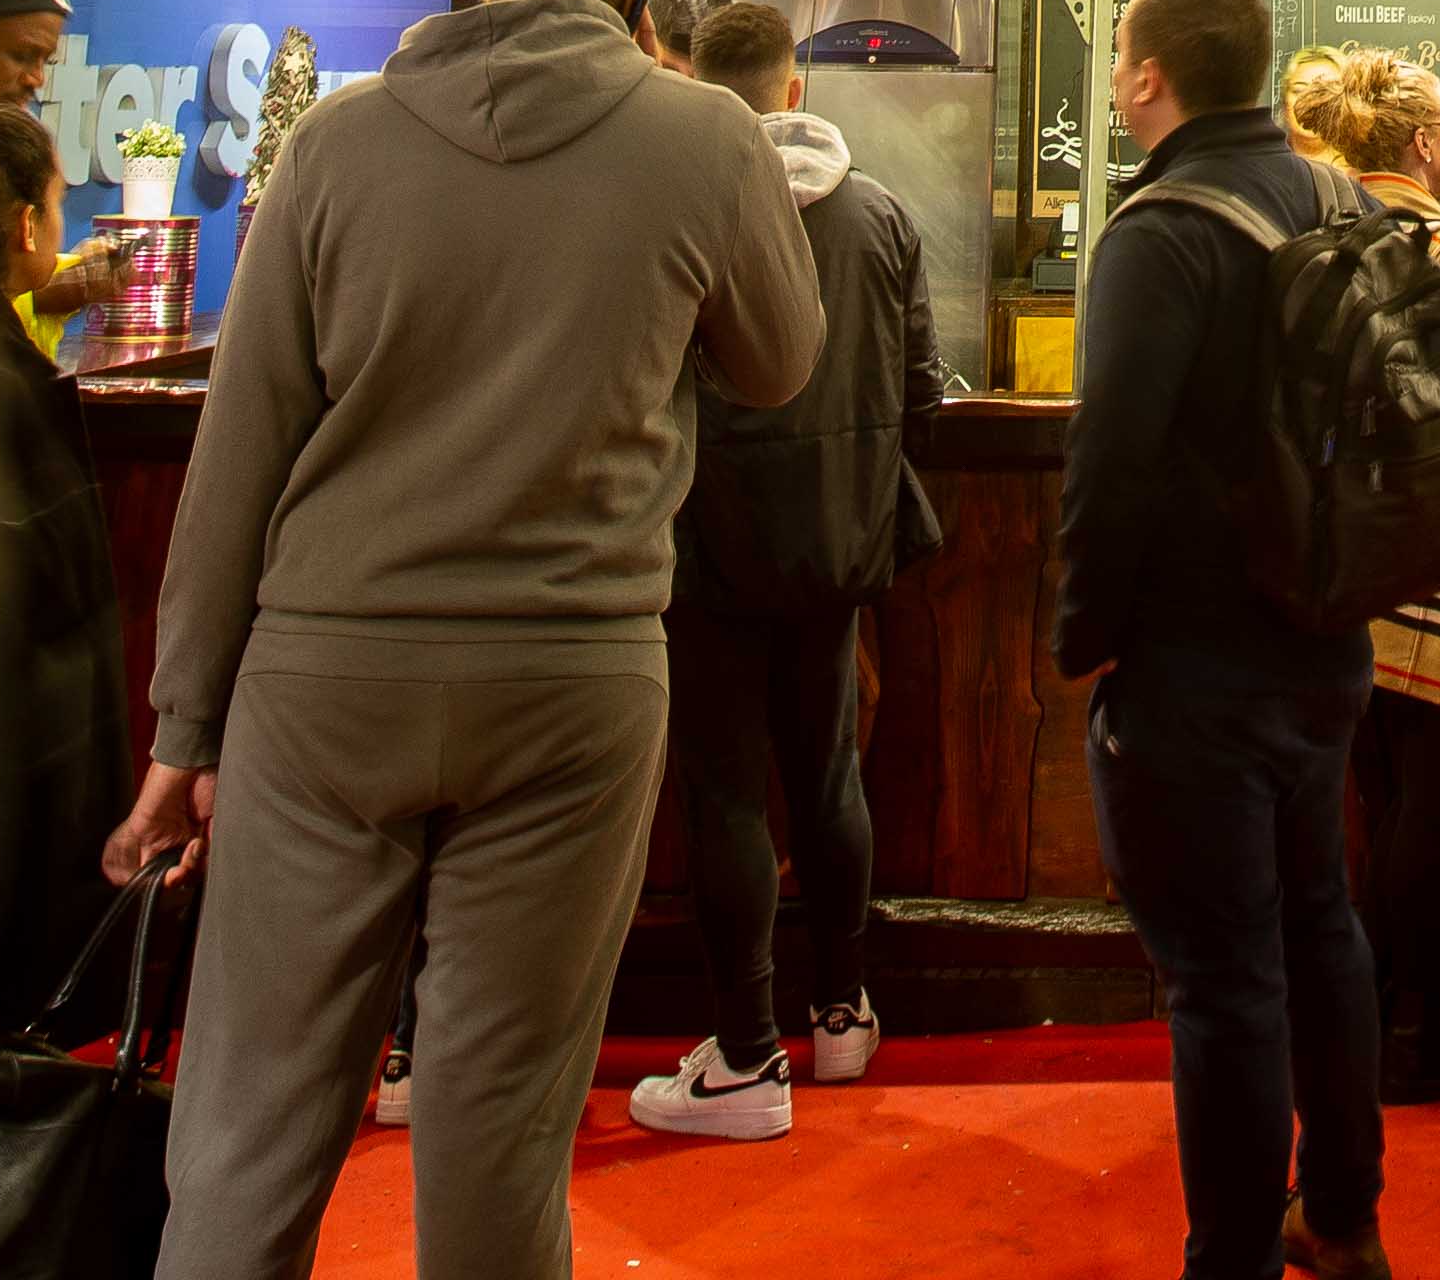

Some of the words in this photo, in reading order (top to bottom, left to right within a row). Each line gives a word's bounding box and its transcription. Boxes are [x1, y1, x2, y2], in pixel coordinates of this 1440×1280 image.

[1335, 5, 1375, 24] CHILLI
[1376, 5, 1407, 24] BEEF
[1407, 13, 1436, 25] (spicy)
